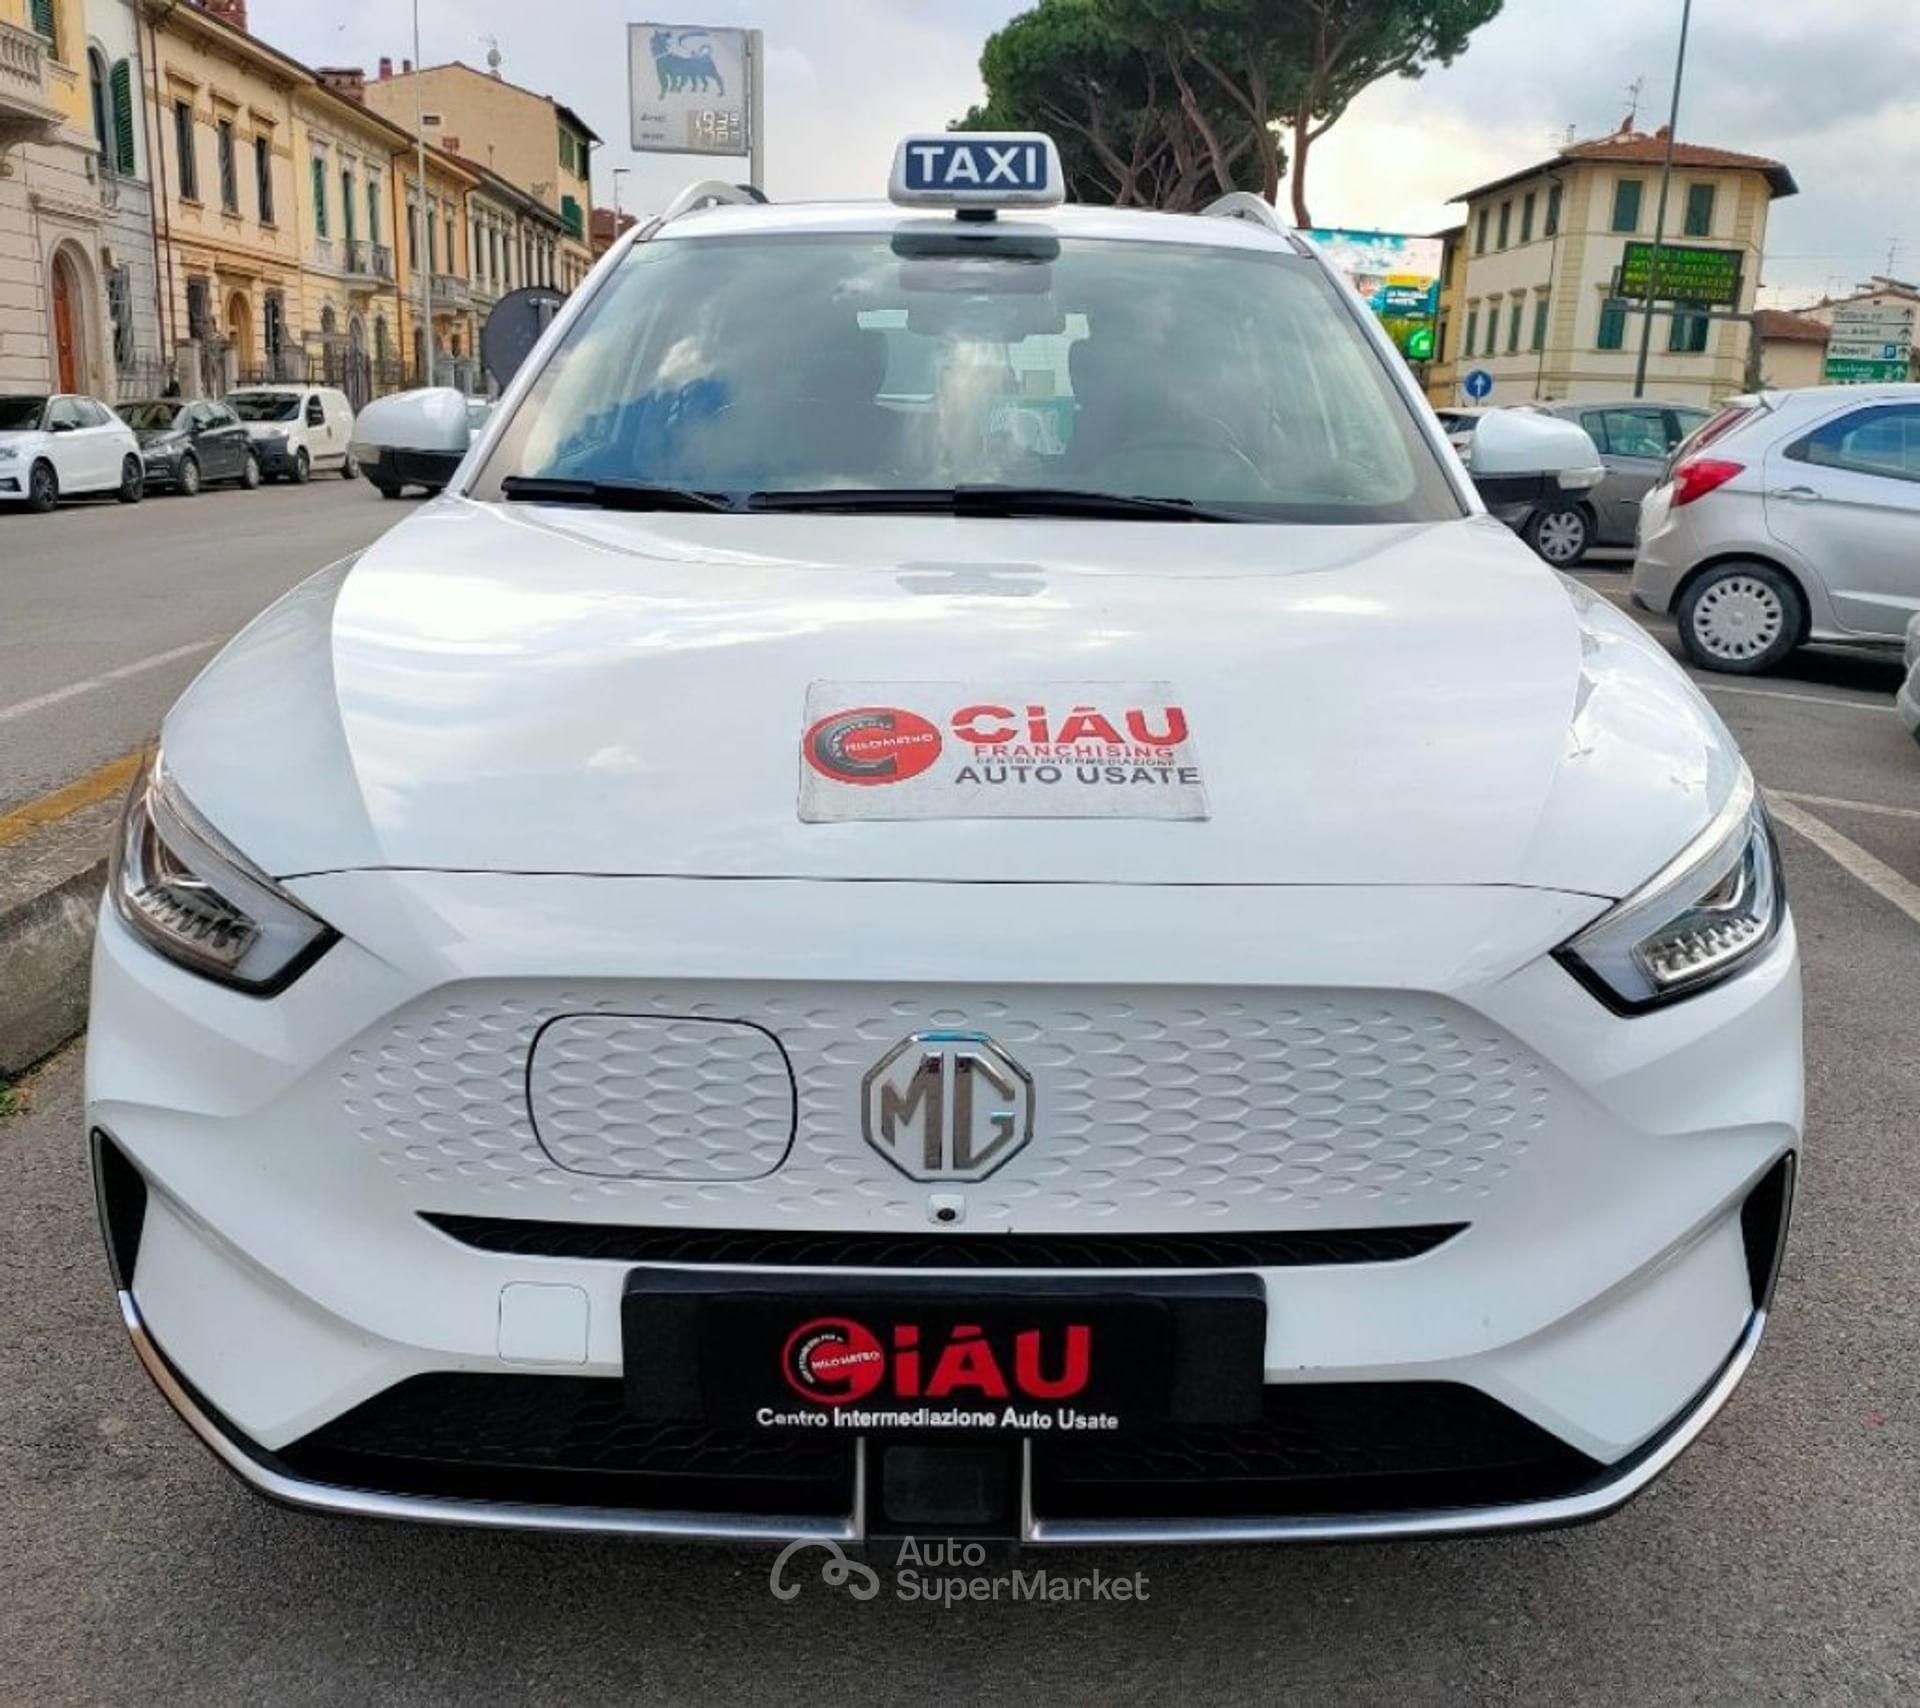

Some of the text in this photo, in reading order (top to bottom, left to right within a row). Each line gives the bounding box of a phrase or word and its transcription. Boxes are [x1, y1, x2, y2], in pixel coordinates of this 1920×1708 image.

[911, 145, 1037, 184] TAXI
[974, 745, 1174, 758] FRANCHISING
[976, 757, 1037, 765] CENTRO
[955, 766, 1201, 785] AUTO USATE
[881, 1053, 1016, 1170] MG
[756, 1407, 1119, 1431] Centro Intermediazione Auto Usate
